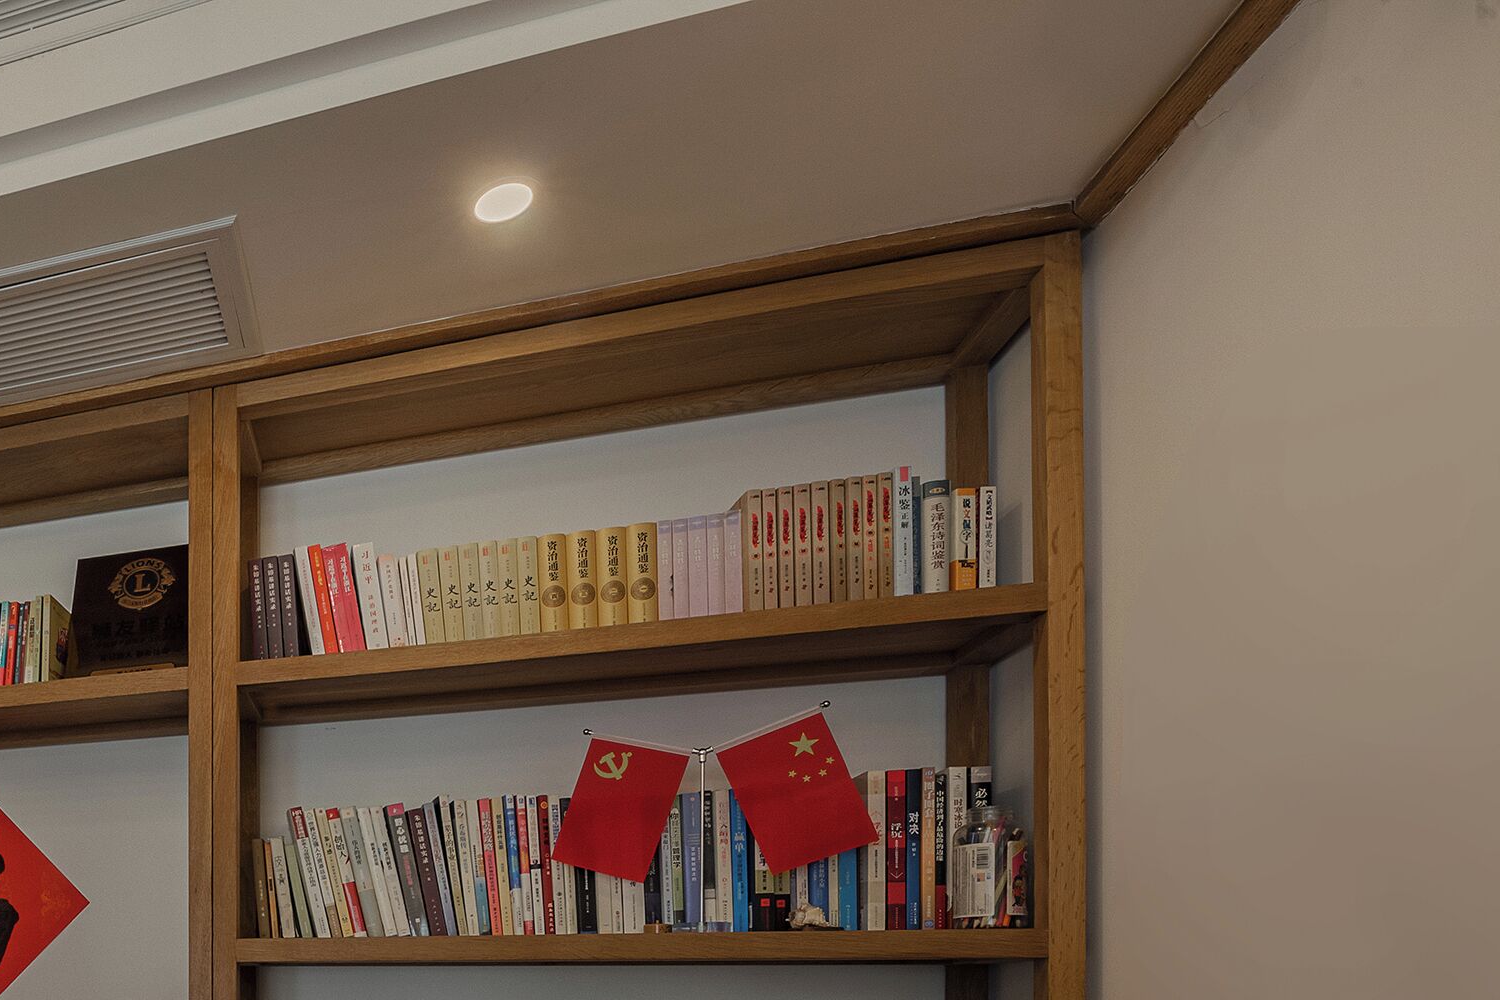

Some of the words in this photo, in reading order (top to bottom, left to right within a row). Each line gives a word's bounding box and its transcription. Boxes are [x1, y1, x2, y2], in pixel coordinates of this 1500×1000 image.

[607, 535, 619, 577] 资治通鉴
[637, 531, 649, 574] 资治通鉴
[931, 502, 945, 569] 毛泽东诗词鉴赏
[124, 560, 162, 572] LIONS
[362, 551, 373, 584] 习近平
[547, 540, 559, 582] 资治通鉴
[577, 537, 589, 579] 资治通鉴
[134, 573, 150, 593] L
[909, 812, 919, 835] 对决
